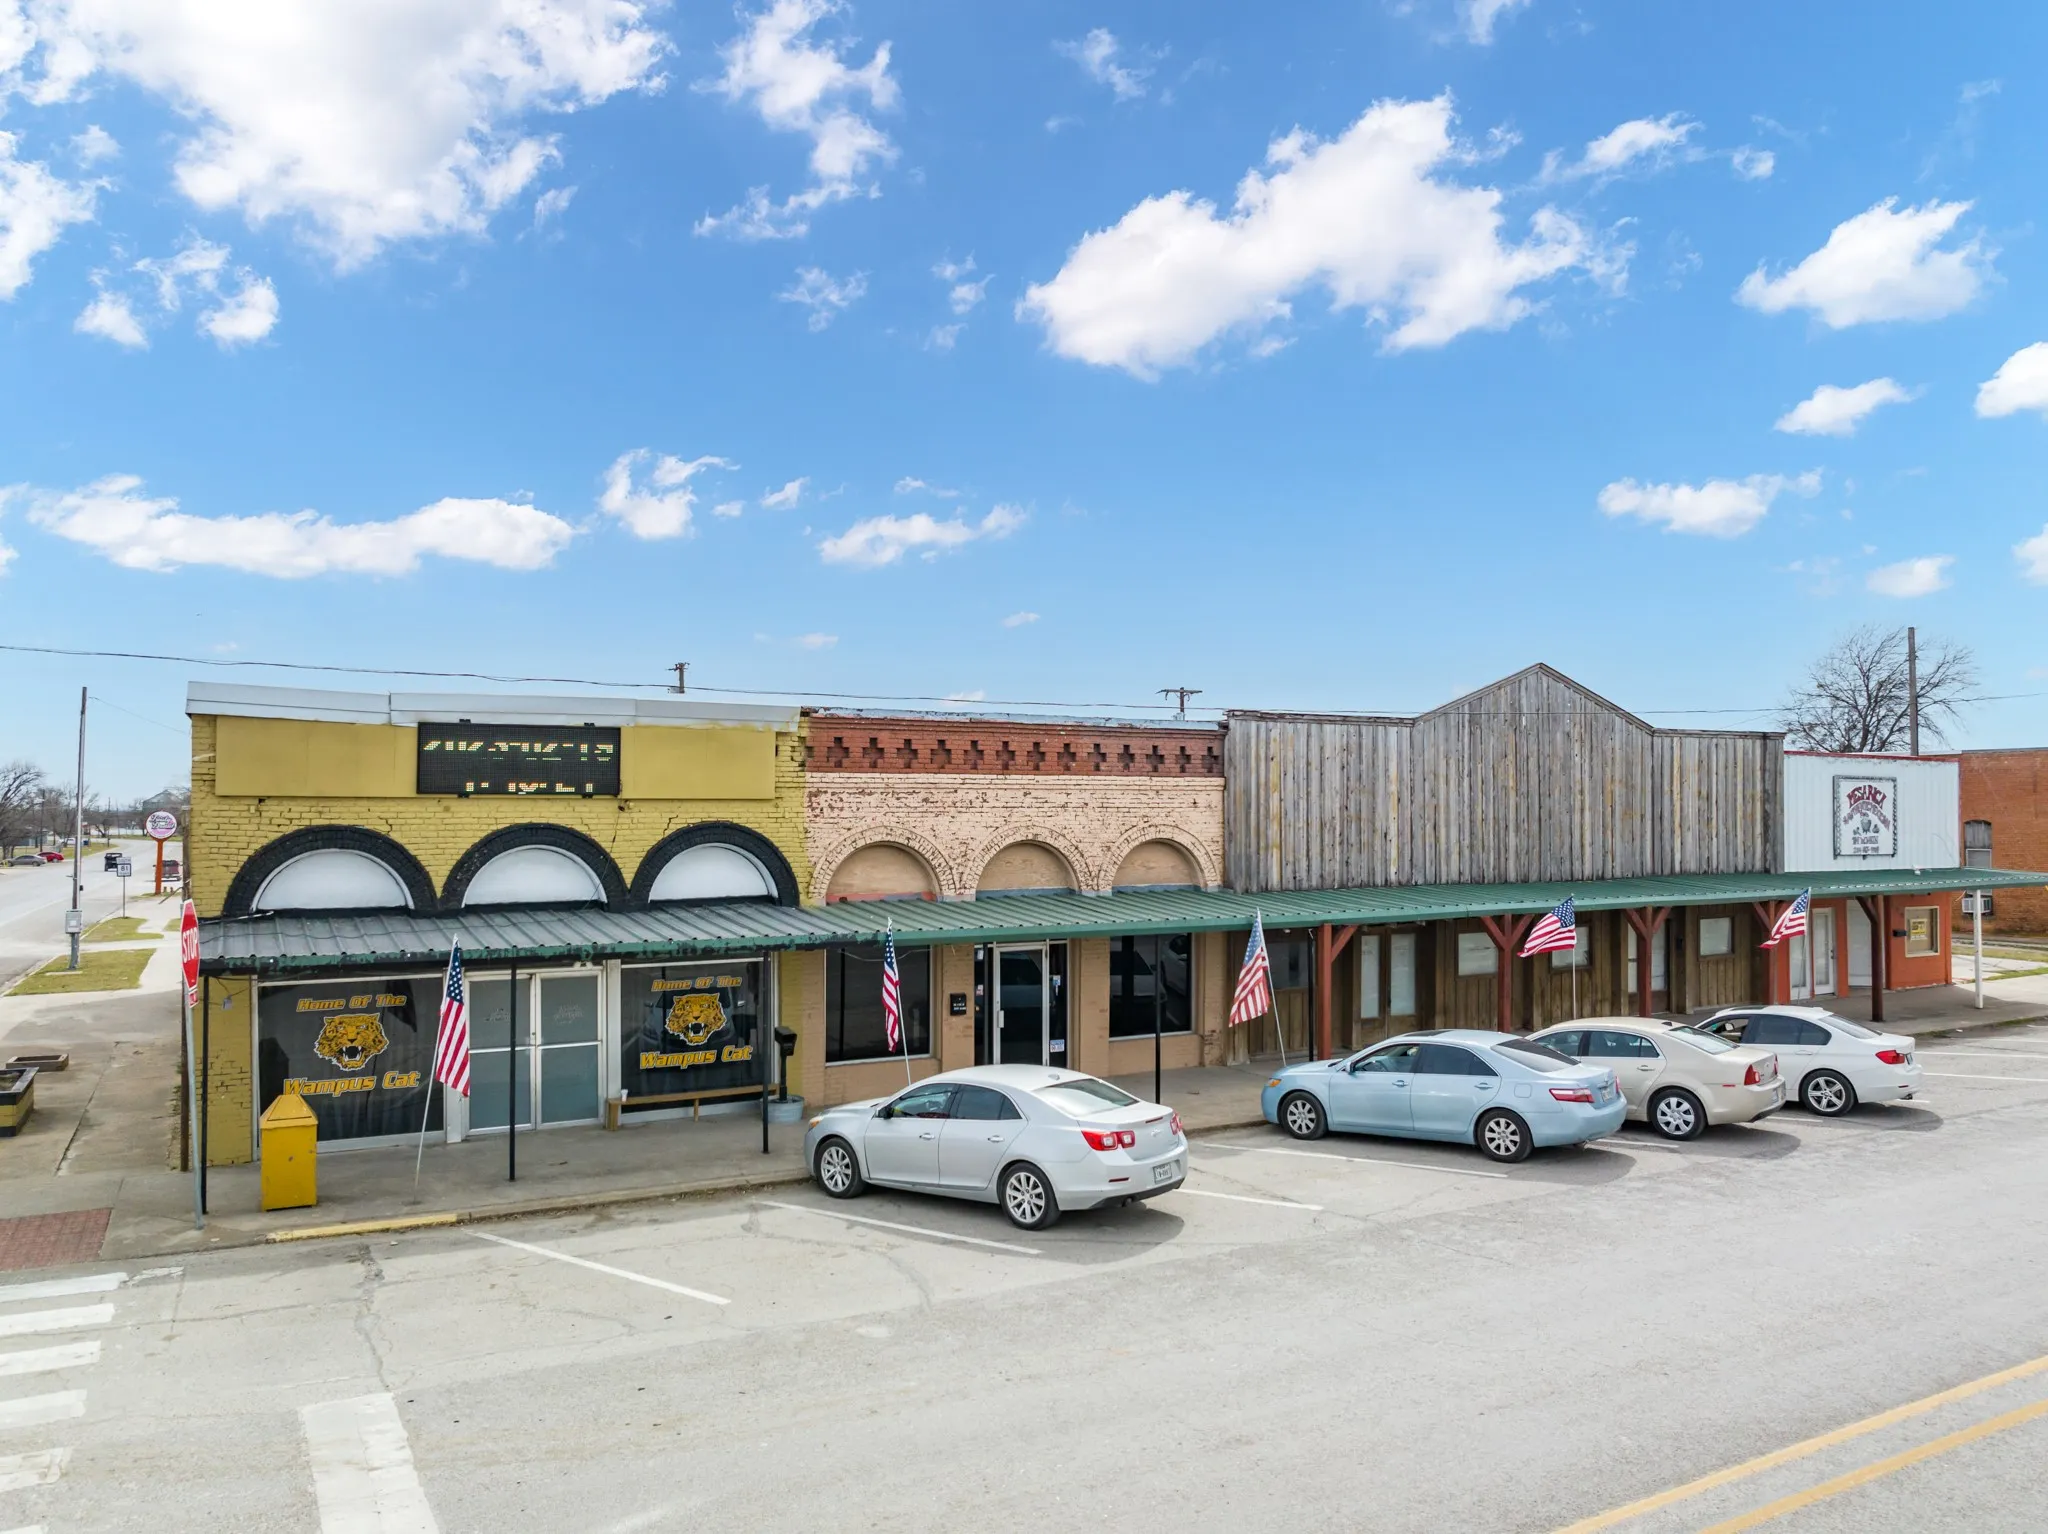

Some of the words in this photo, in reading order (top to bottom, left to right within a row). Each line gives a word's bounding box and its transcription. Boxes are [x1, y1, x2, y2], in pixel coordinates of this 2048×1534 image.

[182, 926, 198, 963] STOP
[652, 980, 691, 991] Home
[695, 976, 714, 988] Of
[717, 975, 742, 987] The
[297, 999, 346, 1012] Home
[349, 995, 372, 1008] Of
[376, 994, 407, 1007] The
[641, 1050, 716, 1069] Wampus
[722, 1045, 753, 1062] Cat
[284, 1076, 376, 1097] Wampus
[383, 1071, 420, 1089] Cat
